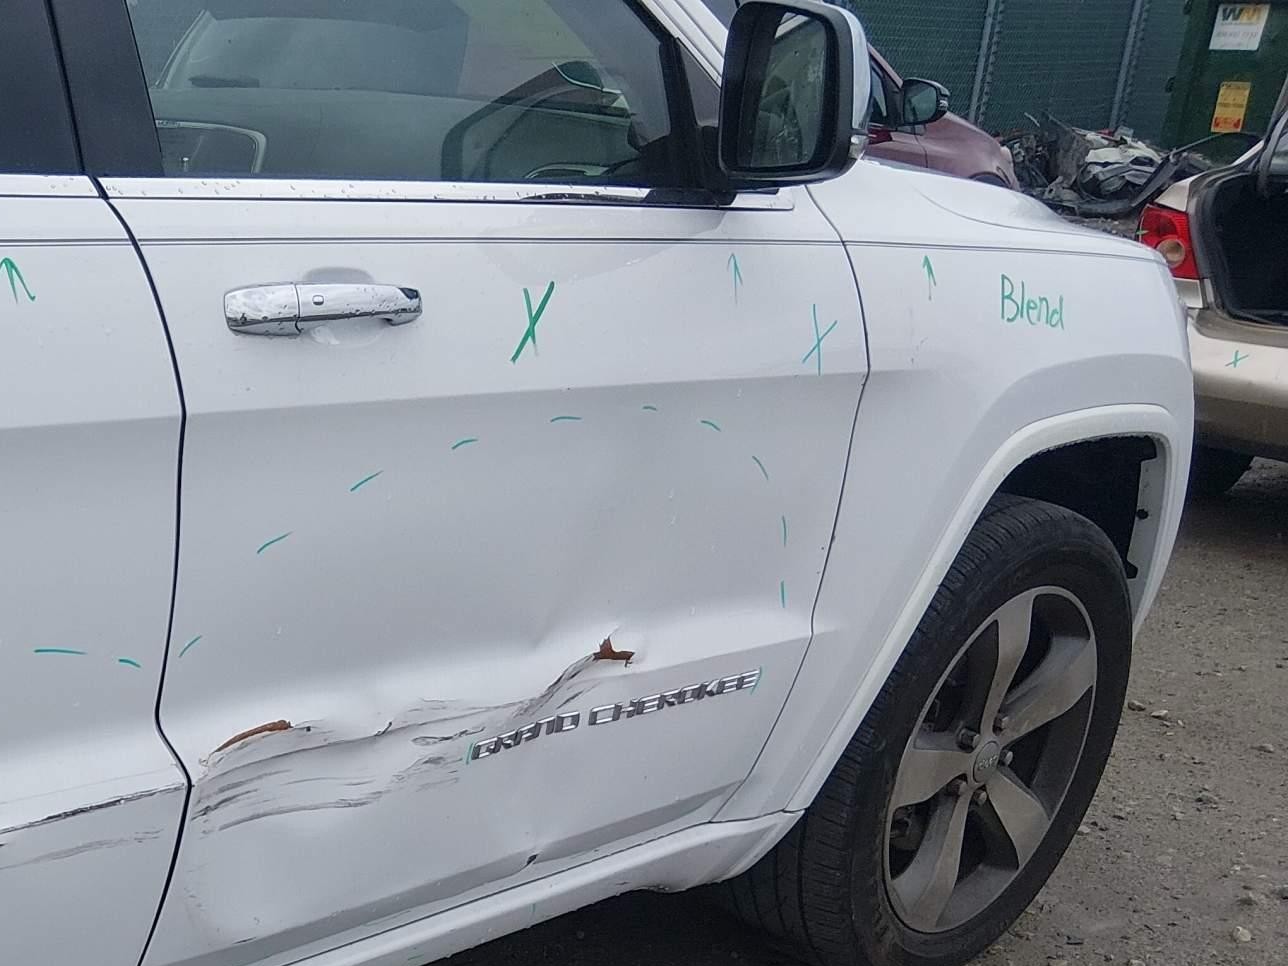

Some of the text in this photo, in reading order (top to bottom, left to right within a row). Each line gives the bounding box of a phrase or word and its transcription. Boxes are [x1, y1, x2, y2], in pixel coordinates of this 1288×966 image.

[1001, 273, 1064, 331] Blend
[471, 668, 761, 761] GRAND CHEROKEE
